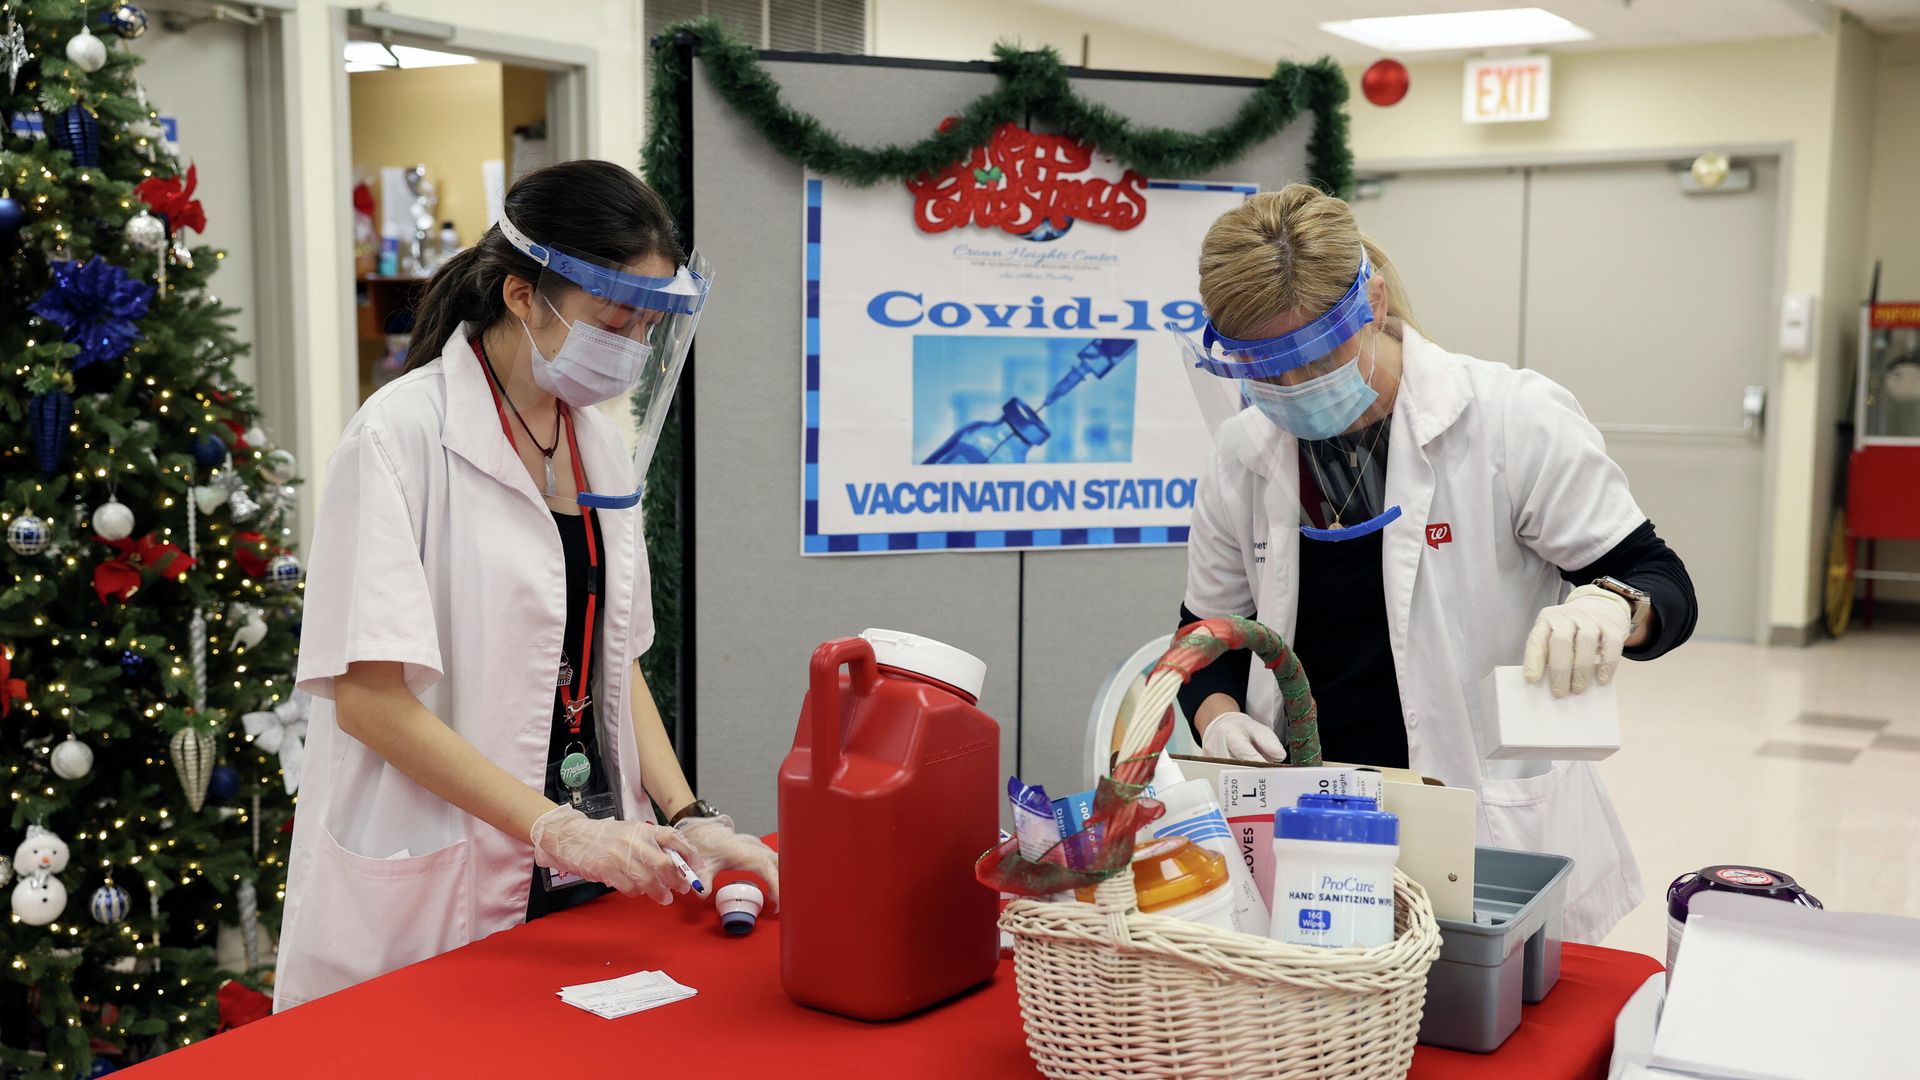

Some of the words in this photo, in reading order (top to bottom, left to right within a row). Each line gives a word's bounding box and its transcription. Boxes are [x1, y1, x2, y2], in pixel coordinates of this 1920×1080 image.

[1476, 65, 1543, 115] EXIT
[867, 290, 1206, 332] Covid-19
[845, 480, 1075, 515] VACCINATION
[1231, 779, 1239, 807] PC520
[1242, 787, 1257, 798] L
[1258, 778, 1267, 808] LARGE
[1242, 827, 1255, 878] LOVES
[1288, 891, 1316, 900] HAND
[1318, 893, 1376, 905] SANITIZING
[1321, 875, 1375, 893] ProCure
[1302, 919, 1327, 929] Wipes
